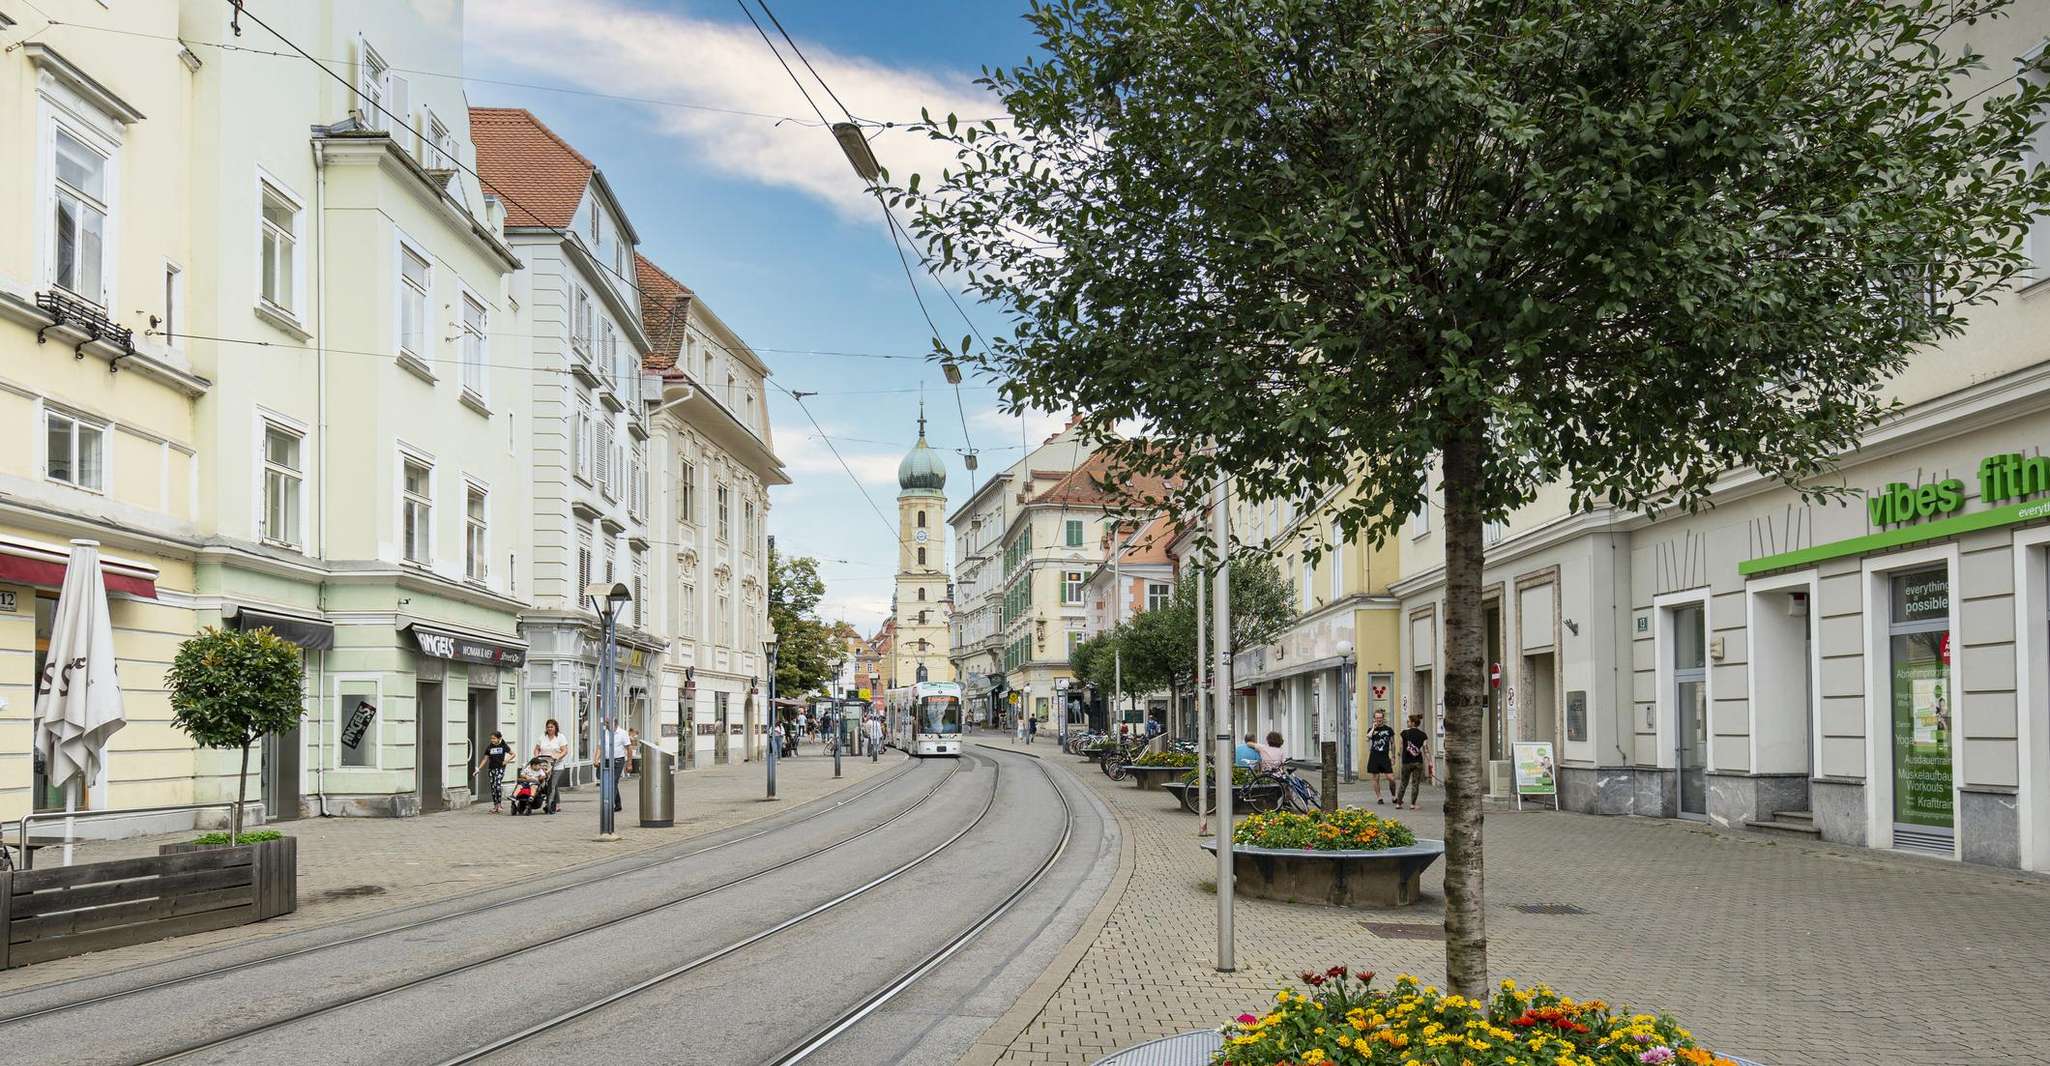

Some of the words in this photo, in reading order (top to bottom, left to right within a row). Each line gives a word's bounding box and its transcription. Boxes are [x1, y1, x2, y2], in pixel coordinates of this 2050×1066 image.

[1868, 478, 1965, 527] vibes
[1977, 453, 2050, 503] fitn
[0, 592, 14, 605] 12
[1905, 596, 1949, 615] possible
[418, 633, 455, 658] ANGELS
[342, 705, 371, 746] ANGELS
[1896, 734, 1914, 748] Yoga
[1906, 780, 1944, 793] Workouts
